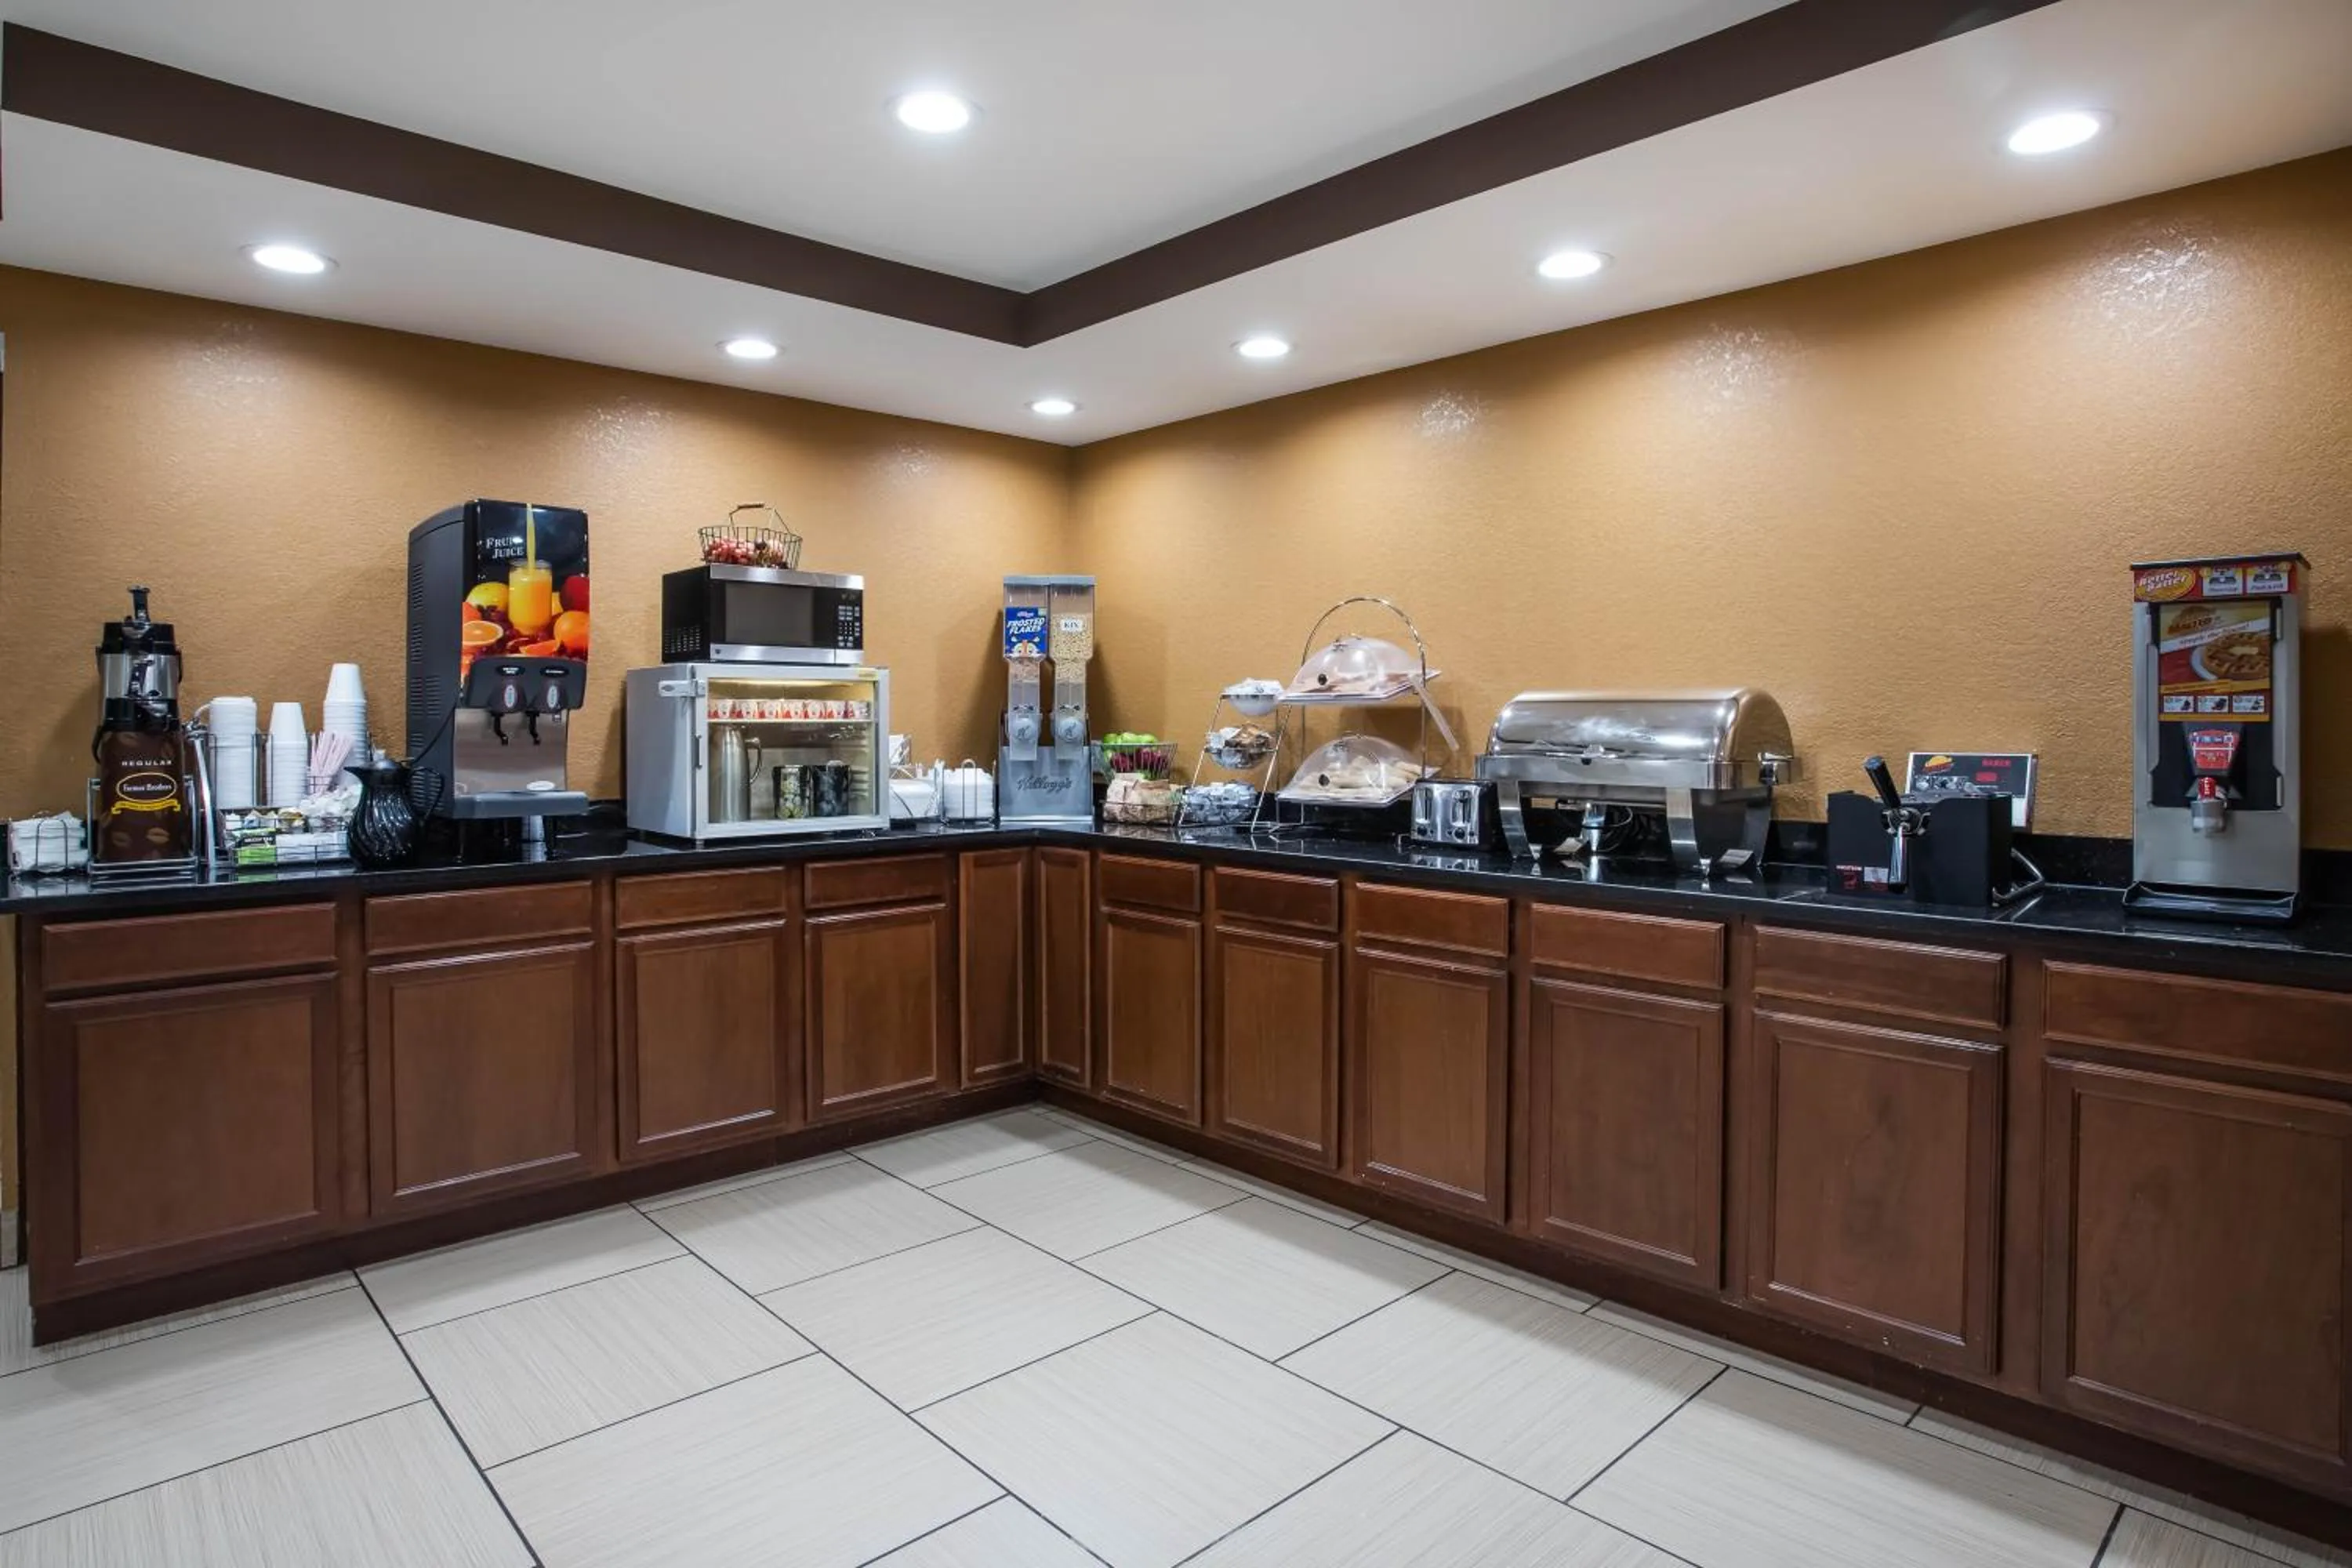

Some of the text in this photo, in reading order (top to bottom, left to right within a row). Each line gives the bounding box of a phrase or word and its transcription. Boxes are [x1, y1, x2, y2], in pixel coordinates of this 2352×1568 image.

[492, 546, 524, 559] JUICE
[1007, 617, 1045, 628] FROSTED
[1010, 626, 1041, 634] FLAKES
[1017, 775, 1073, 793] Kellogg's
